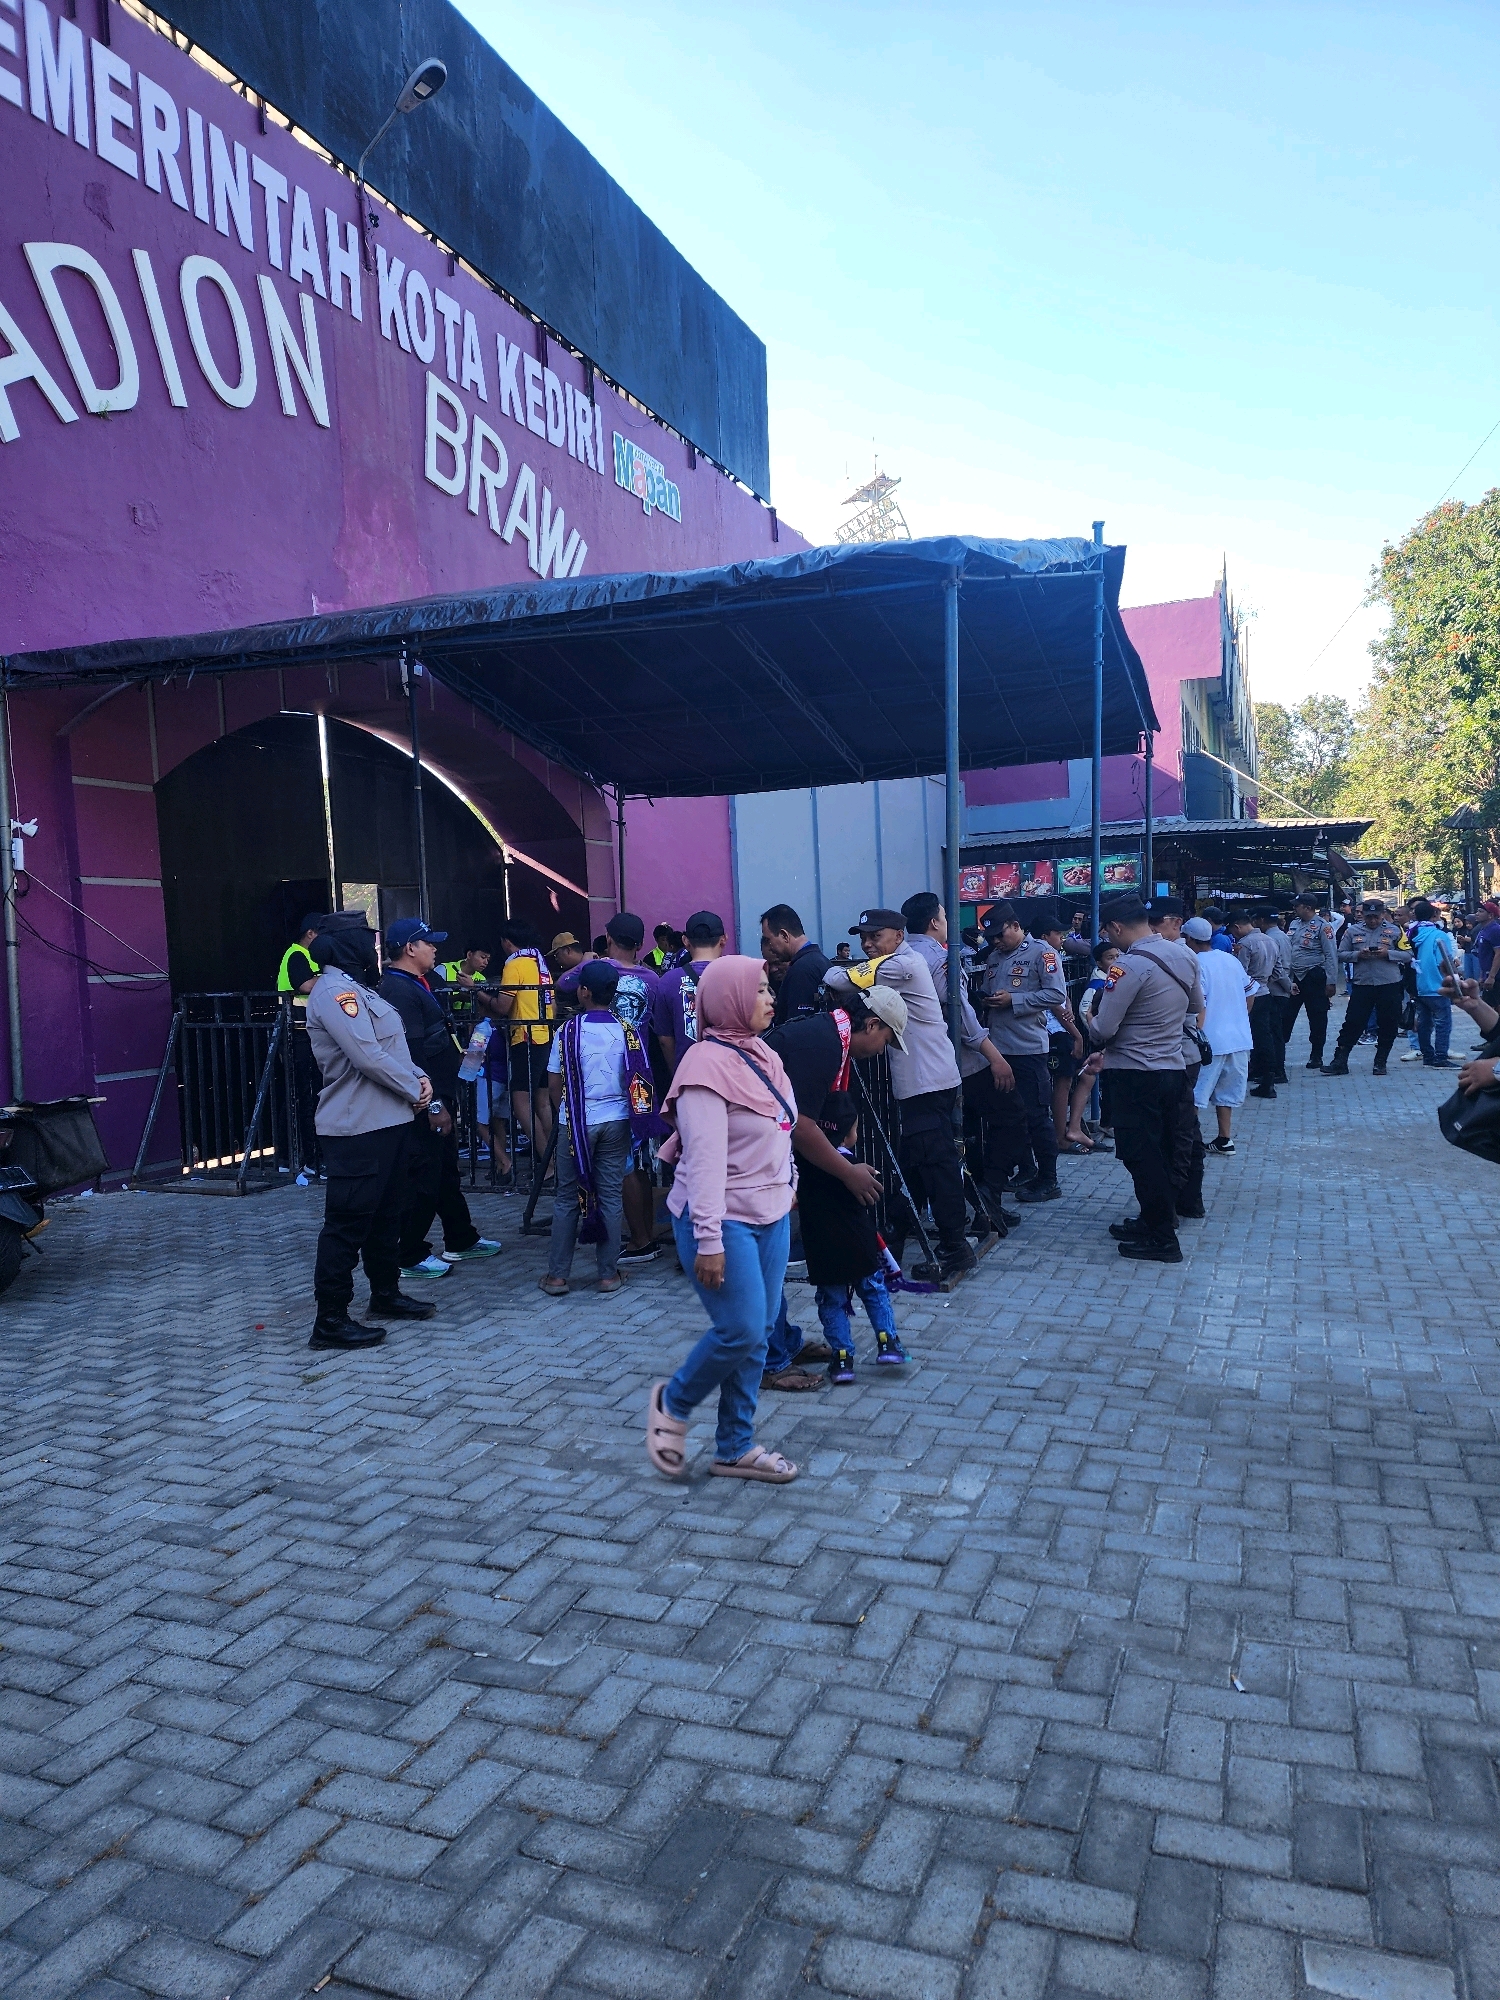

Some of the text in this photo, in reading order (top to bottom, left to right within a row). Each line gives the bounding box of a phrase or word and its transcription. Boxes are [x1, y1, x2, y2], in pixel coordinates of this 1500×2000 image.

[376, 244, 488, 403] KOTA
[497, 333, 605, 476] KEDIRI
[613, 431, 681, 523] Mapan
